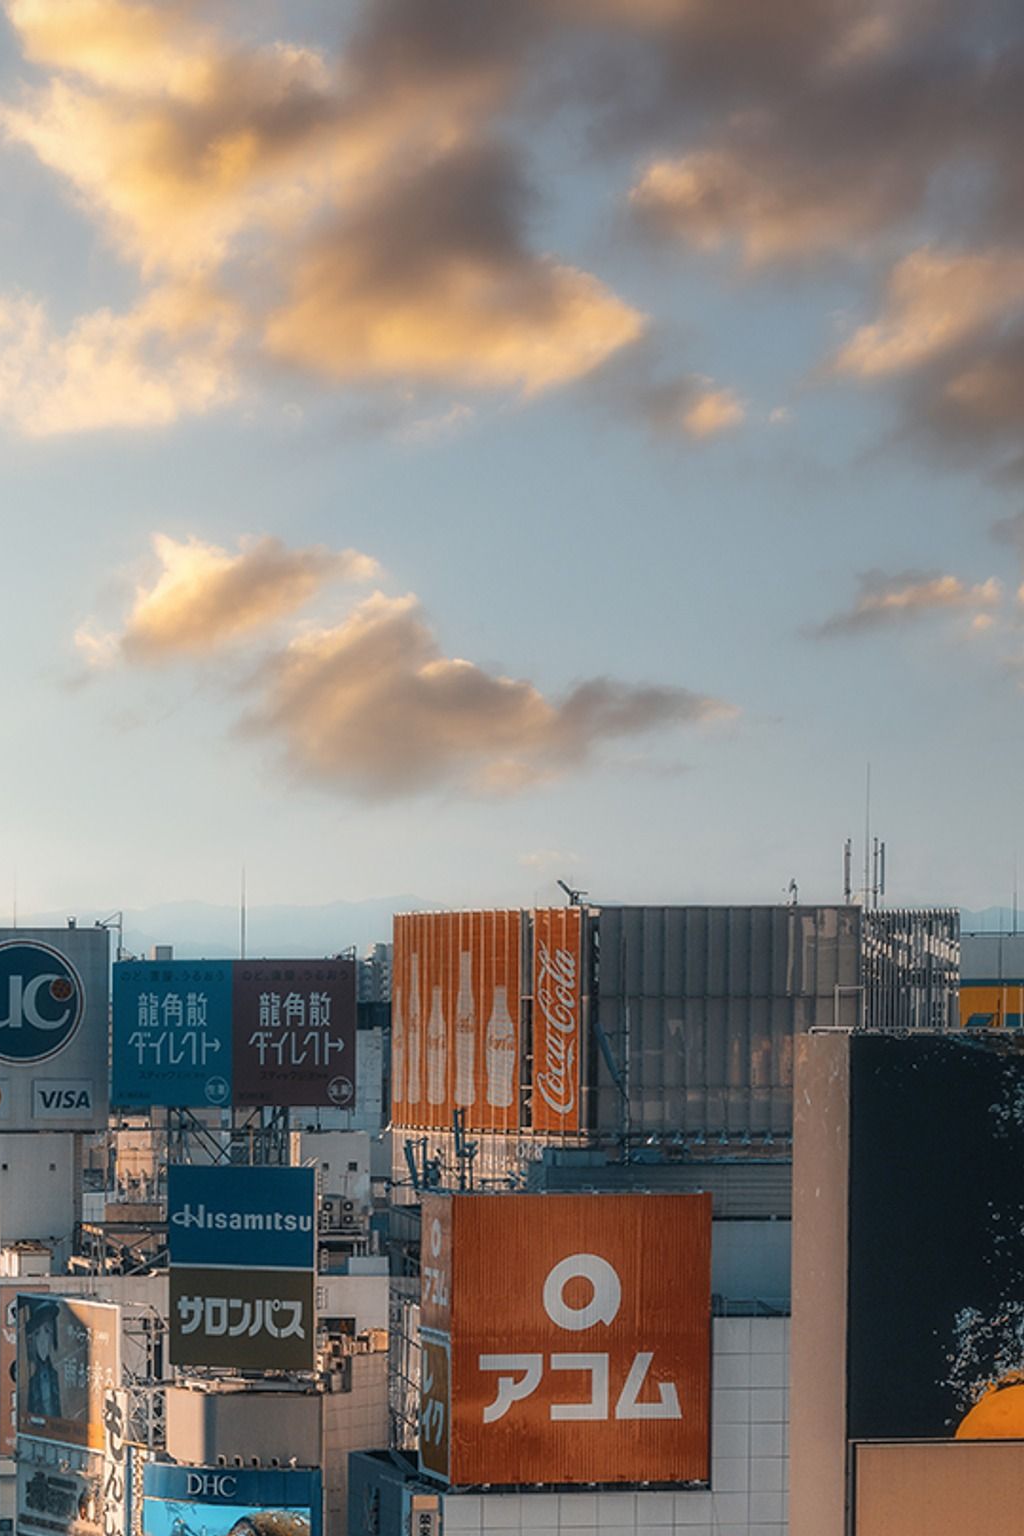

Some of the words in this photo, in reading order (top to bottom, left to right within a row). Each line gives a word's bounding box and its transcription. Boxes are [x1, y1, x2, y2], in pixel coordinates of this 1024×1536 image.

[137, 991, 208, 1028] 龍角散
[259, 991, 332, 1028] 龍角散
[536, 939, 576, 1115] Coca-Cola
[128, 1031, 221, 1066] ダイレクト
[248, 1031, 345, 1066] ダイレクト
[39, 1090, 91, 1109] VISA
[172, 1203, 313, 1232] Hisamitsu
[177, 1295, 306, 1340] サロンパス
[478, 1352, 683, 1424] アコム
[186, 1472, 236, 1497] DHC
